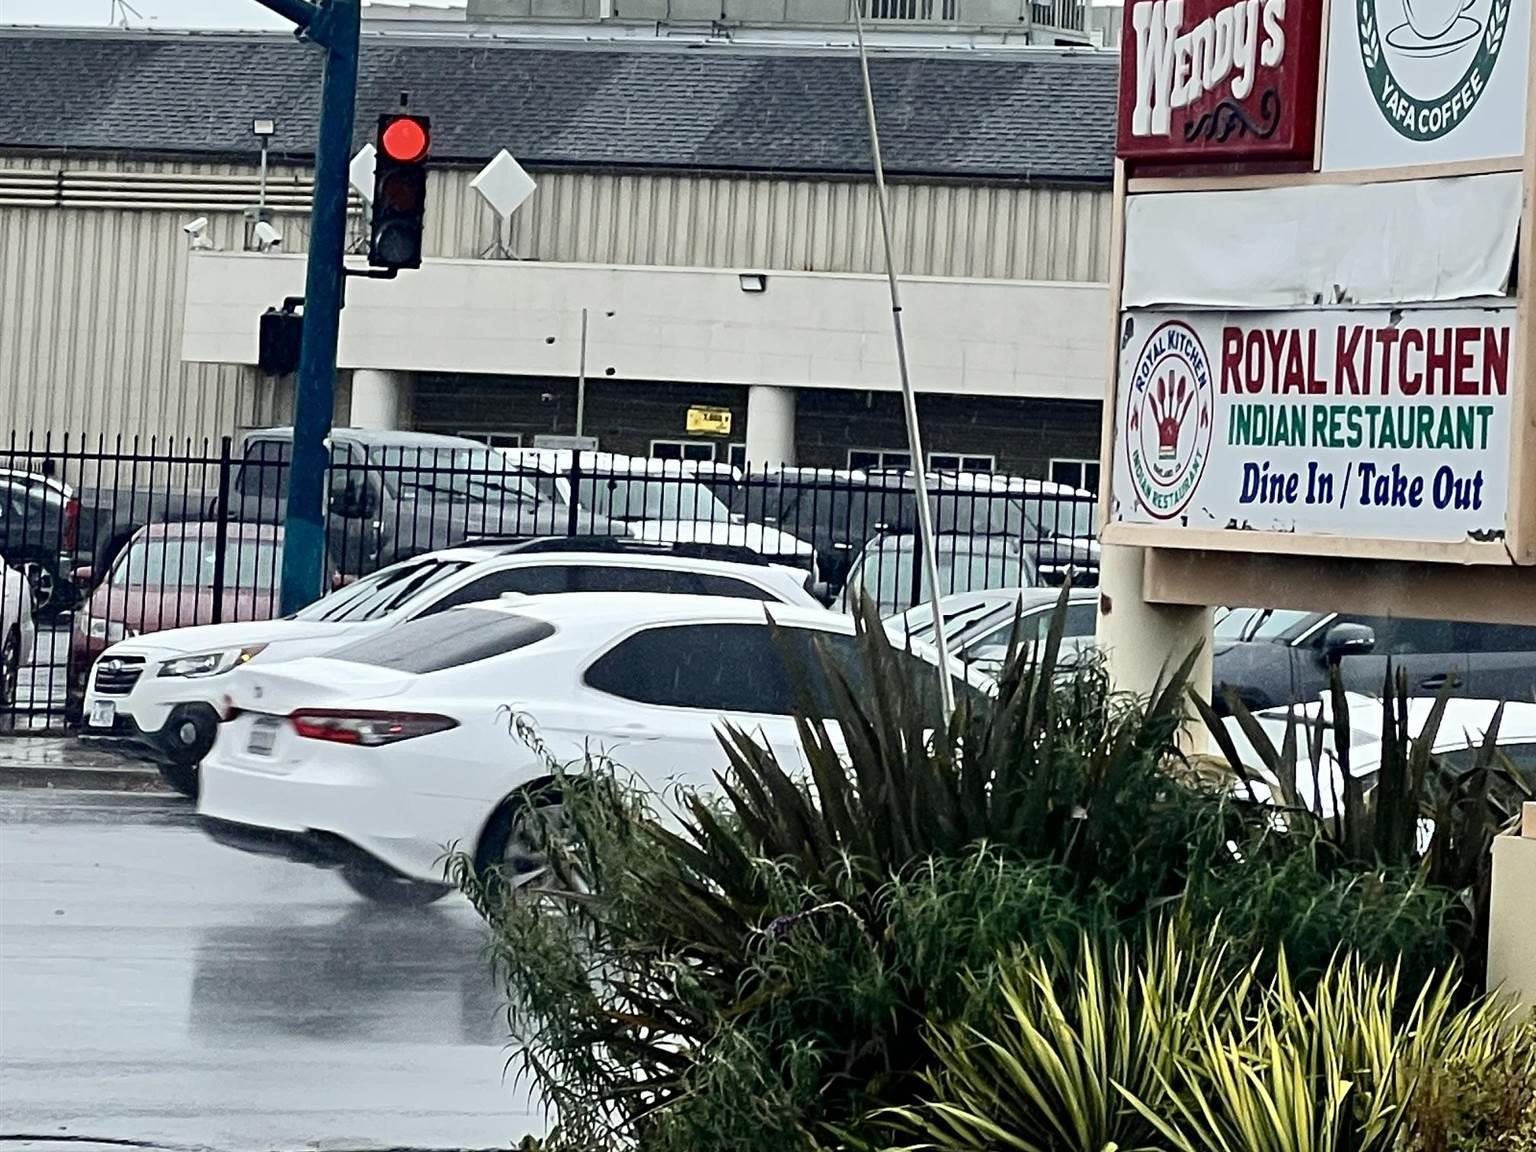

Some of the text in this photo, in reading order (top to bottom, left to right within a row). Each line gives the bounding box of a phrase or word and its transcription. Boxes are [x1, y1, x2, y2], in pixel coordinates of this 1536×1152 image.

[1379, 67, 1484, 133] YAFA COFFEE
[1135, 329, 1207, 393] ROYAL KITCHEN
[1219, 325, 1511, 396] ROYAL KITCHEN
[1228, 404, 1494, 450] INDIAN RESTAURANT
[1132, 448, 1202, 509] INDIAN RESTAURANT
[1238, 461, 1299, 505] Dine
[1305, 461, 1333, 506] In
[1358, 462, 1423, 509] Take
[1432, 465, 1484, 511] Out
